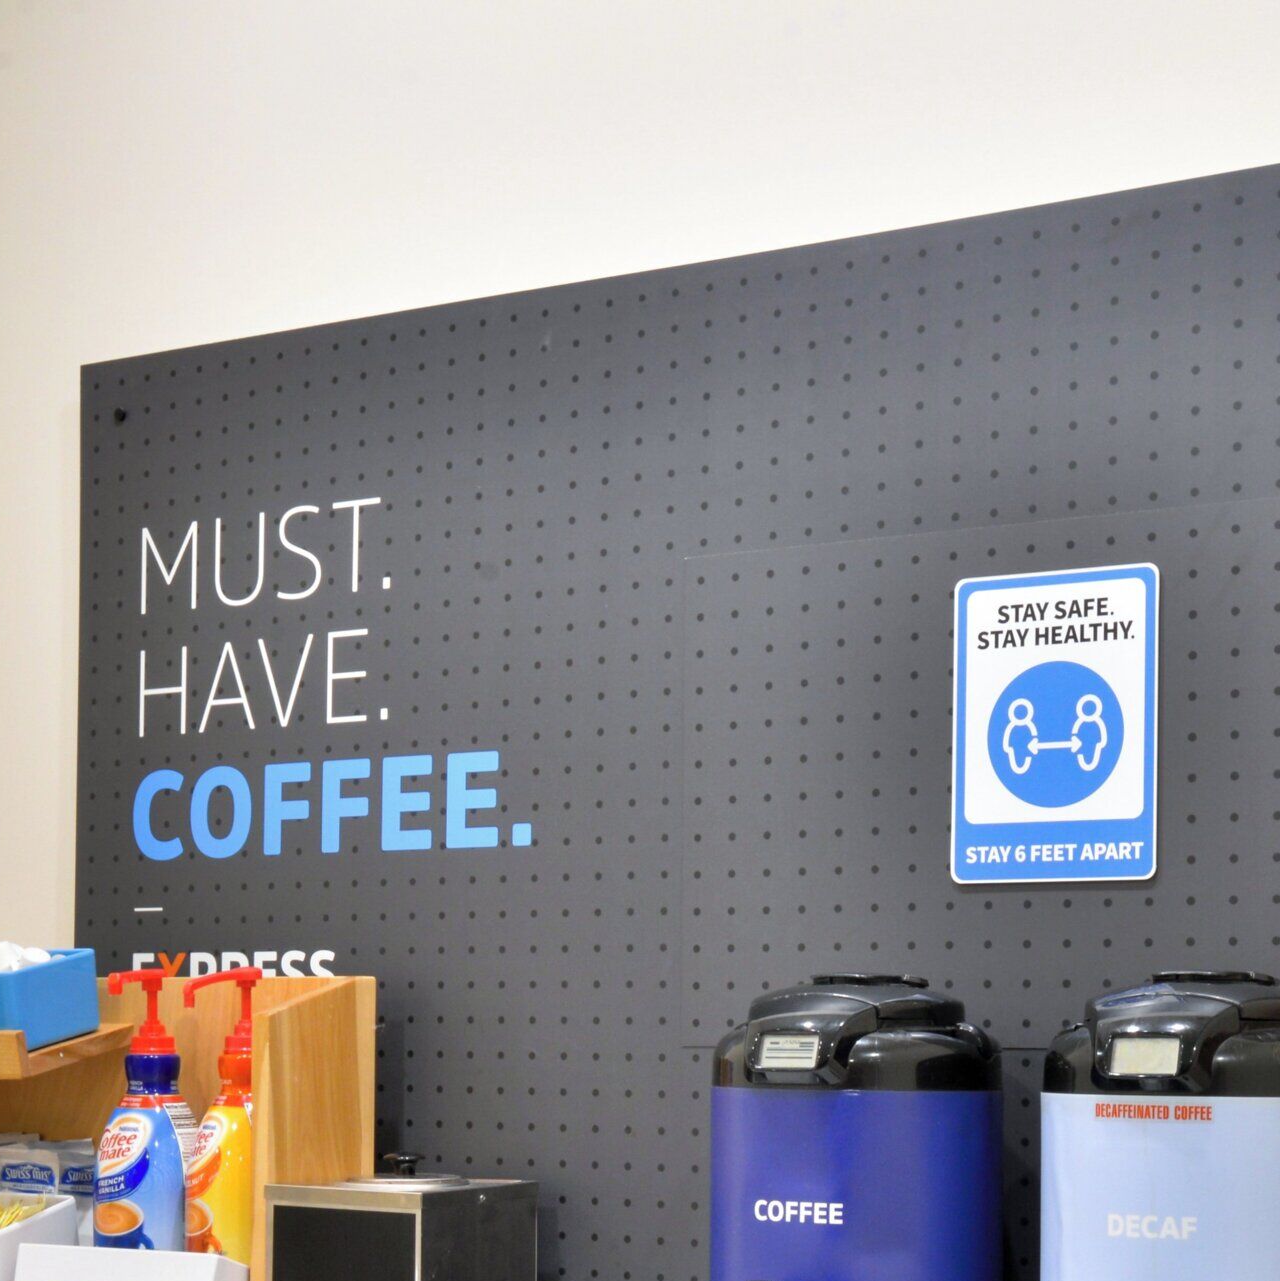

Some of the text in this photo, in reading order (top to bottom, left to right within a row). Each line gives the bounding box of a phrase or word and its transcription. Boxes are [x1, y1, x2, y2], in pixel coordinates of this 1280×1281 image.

[140, 497, 391, 614] MUST.
[998, 597, 1114, 624] STAY SAFE.
[977, 620, 1135, 650] STAY HEALTHY.
[138, 628, 389, 737] HAVE.
[132, 750, 532, 861] COFFEE.
[966, 841, 1144, 864] STAY 6 FEET APART
[1095, 1103, 1212, 1121] DECAFFEINATED COFFEE
[754, 1199, 844, 1225] COFFEE
[1107, 1213, 1197, 1240] DECAF
